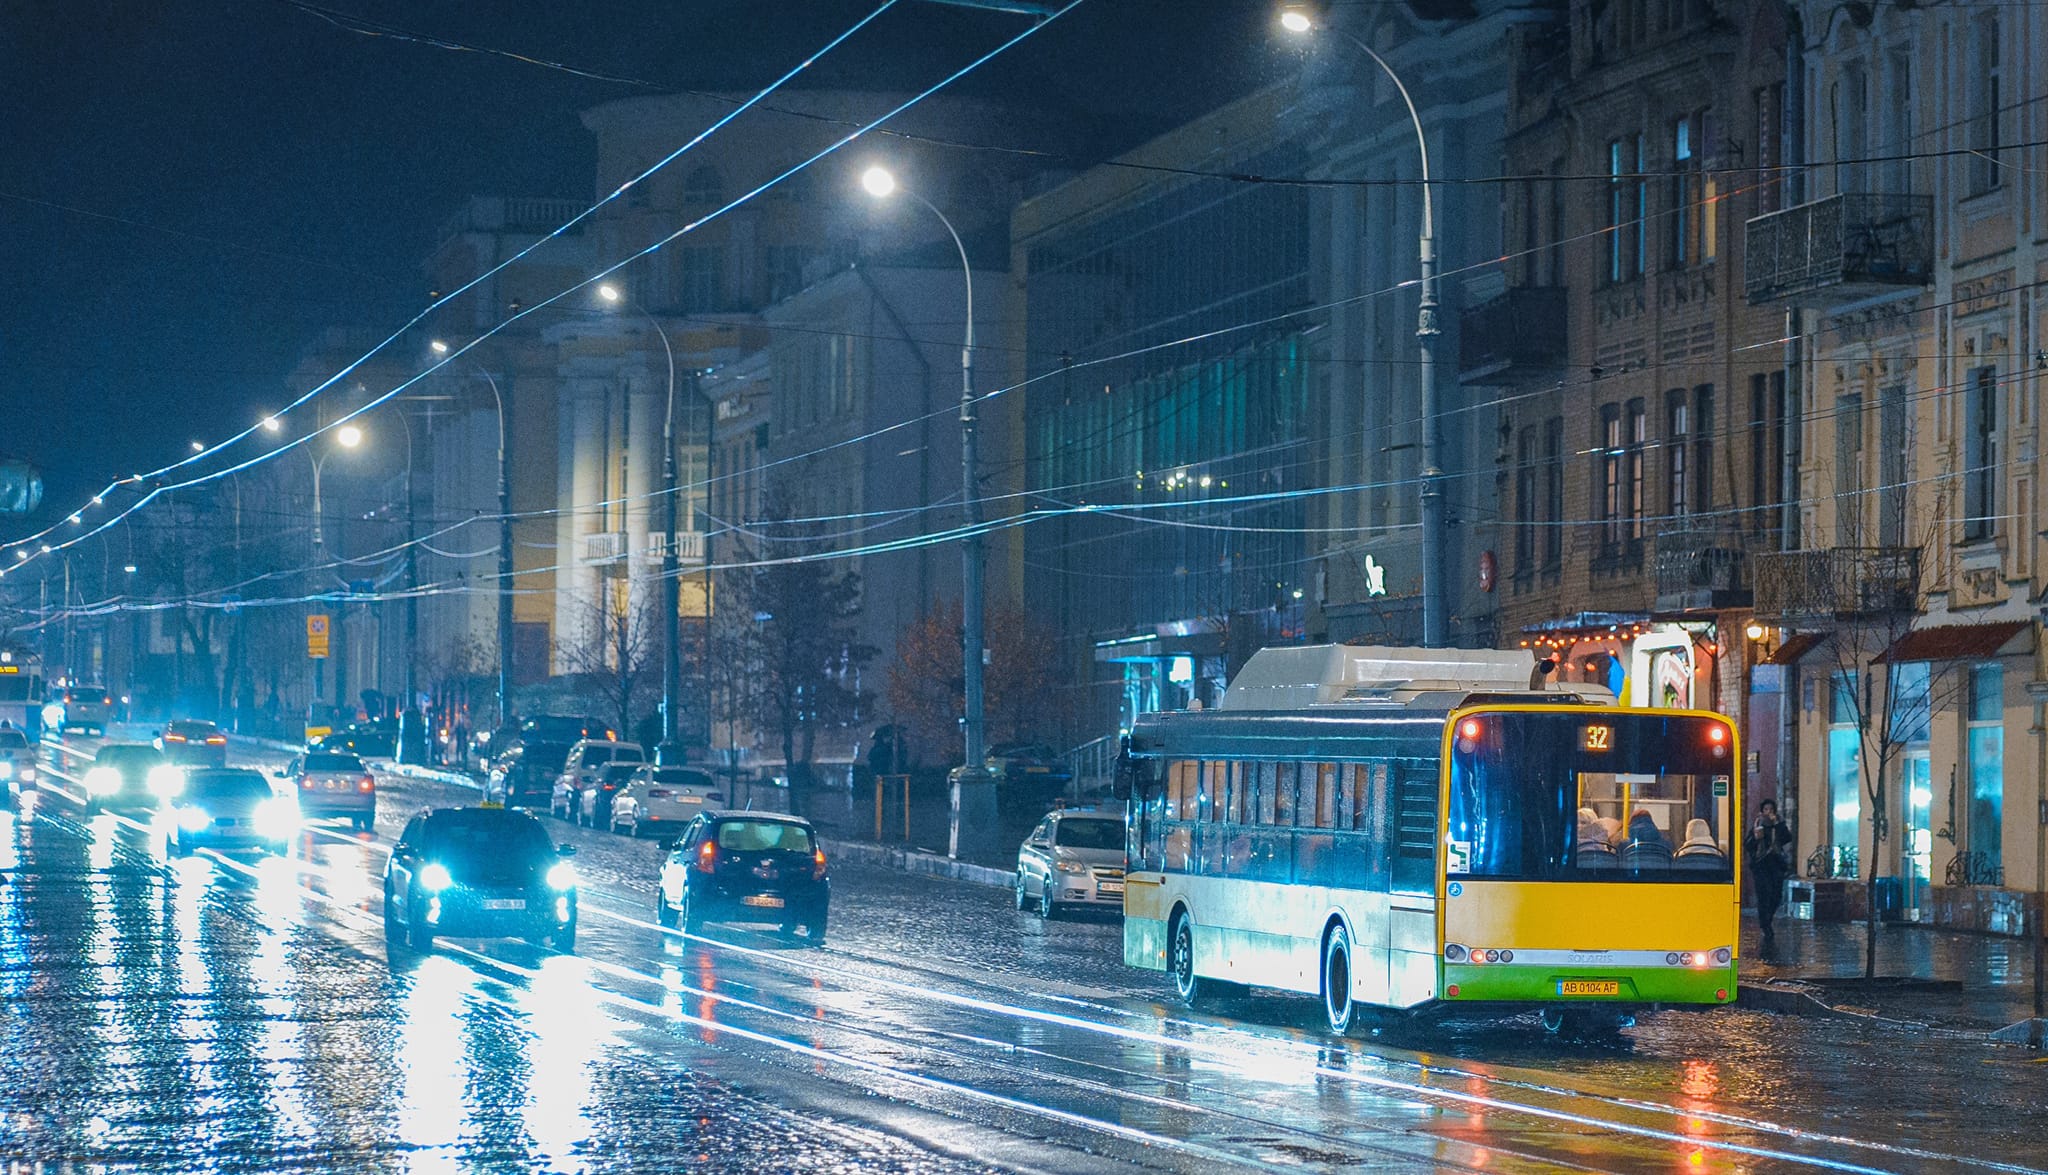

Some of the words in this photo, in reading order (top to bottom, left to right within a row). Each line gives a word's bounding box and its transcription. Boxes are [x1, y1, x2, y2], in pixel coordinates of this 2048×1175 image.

[1587, 726, 1608, 748] 32
[1567, 954, 1614, 963] SOLARIS
[1564, 983, 1577, 992] AB
[1579, 983, 1601, 993] 0104
[1603, 983, 1617, 993] AF
